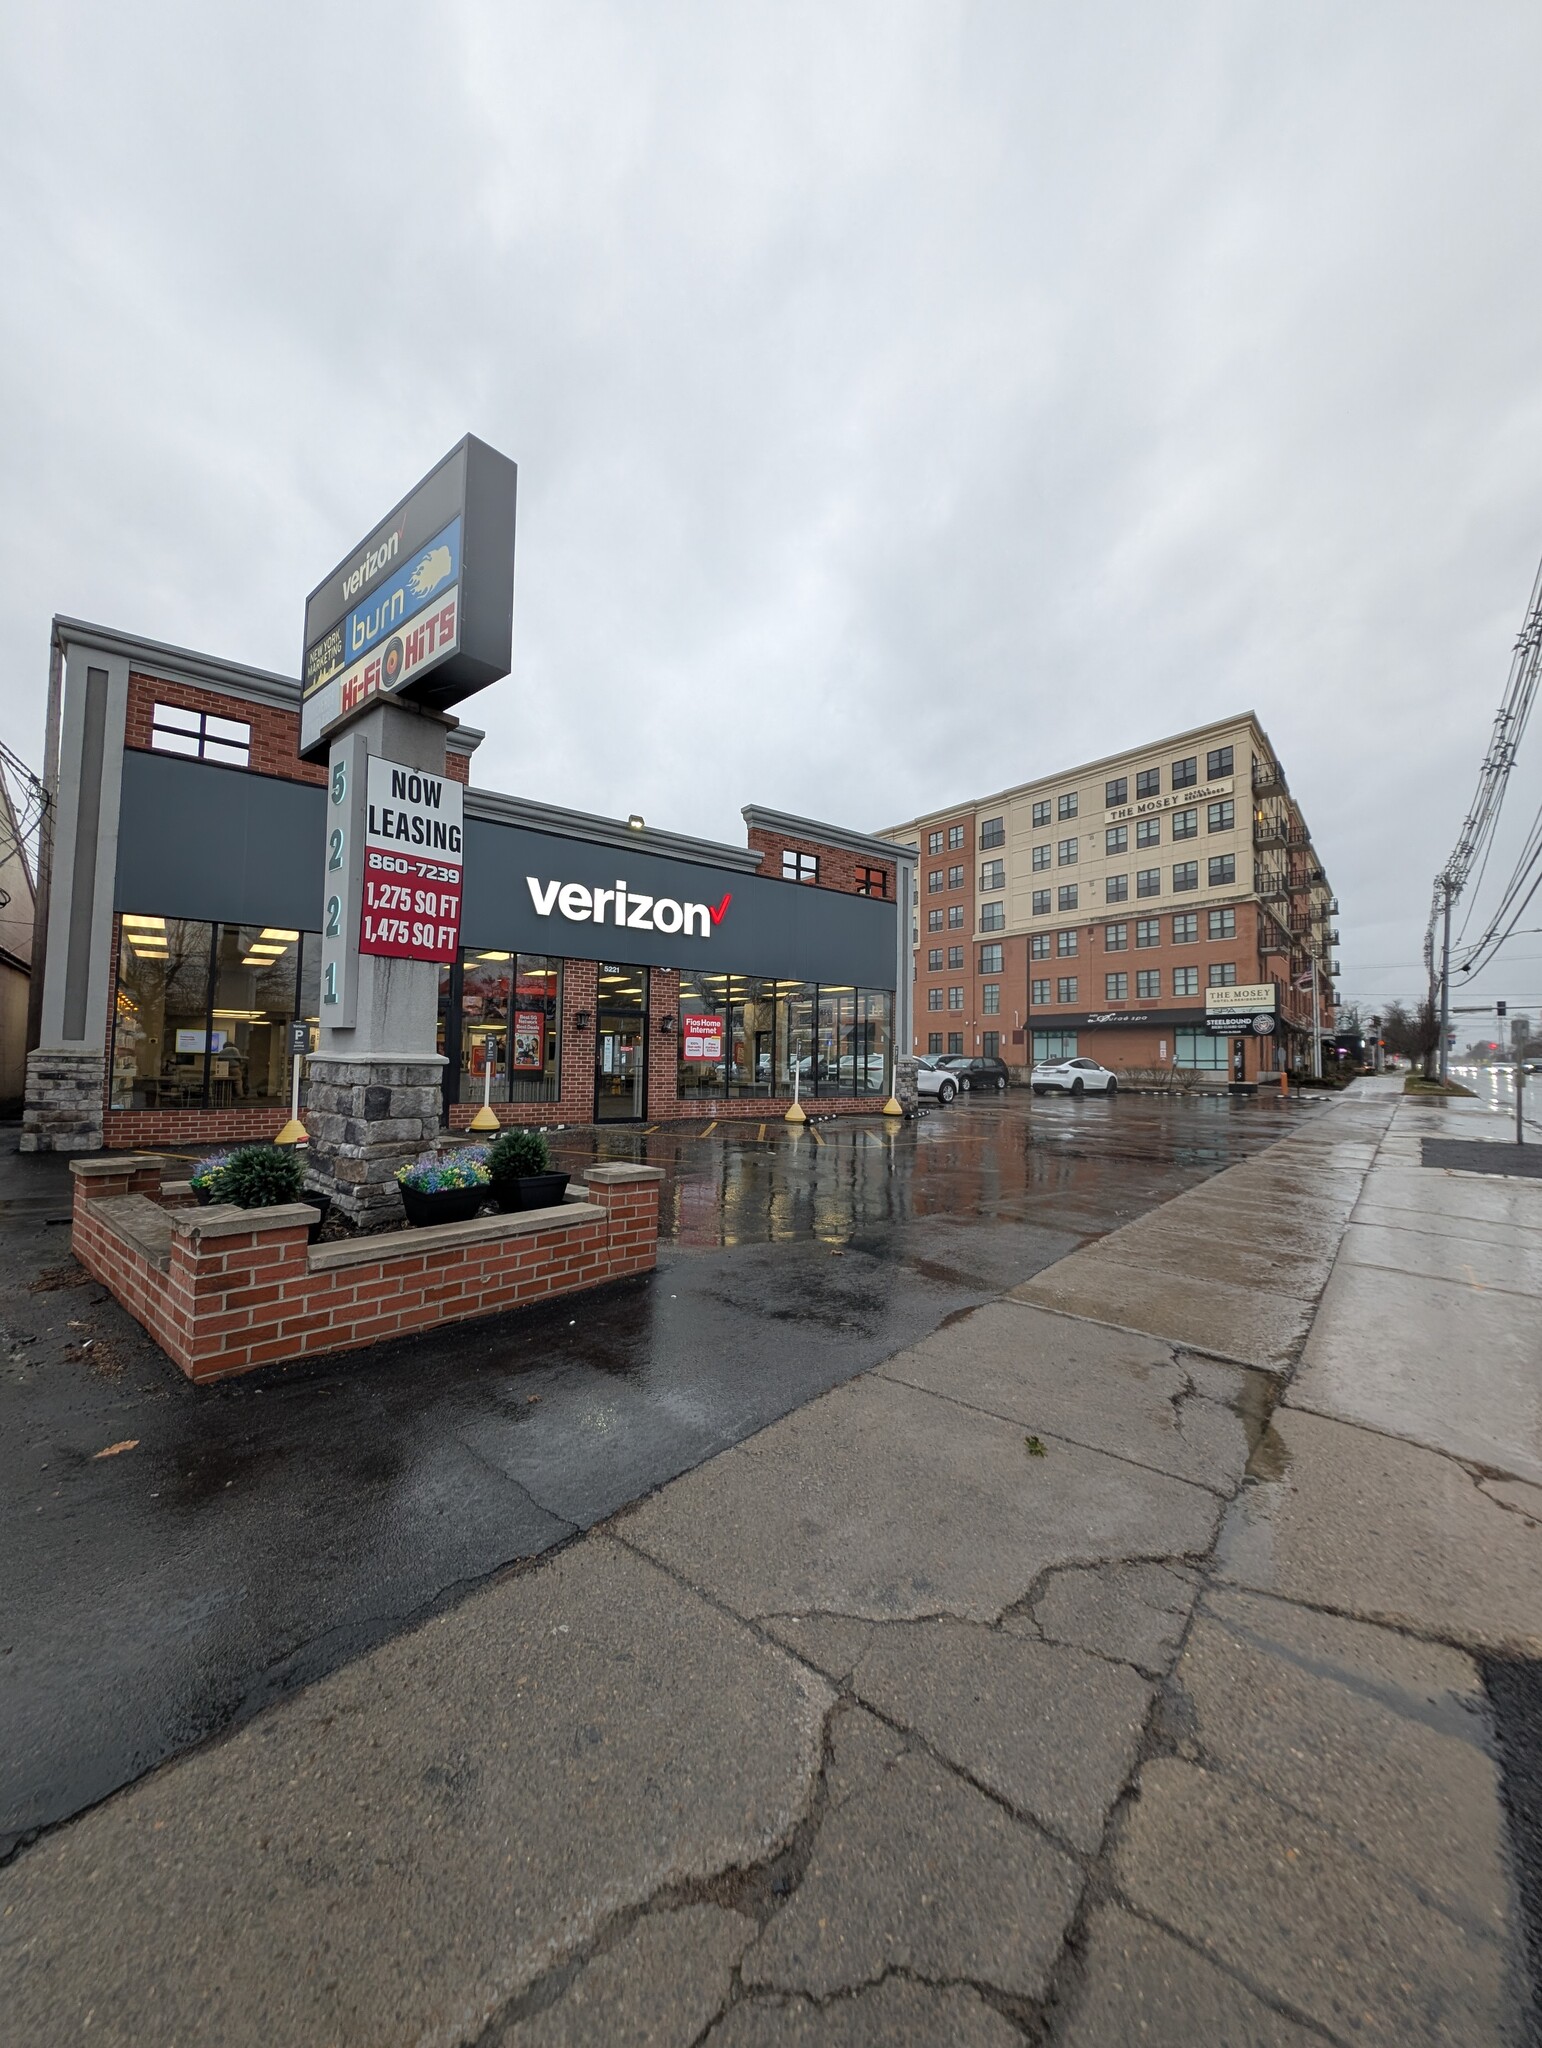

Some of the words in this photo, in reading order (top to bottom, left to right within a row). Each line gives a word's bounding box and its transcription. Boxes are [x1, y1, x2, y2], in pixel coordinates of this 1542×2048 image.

[342, 530, 399, 601] verizon
[352, 587, 404, 651] burn
[307, 640, 342, 679] MARKETING
[309, 643, 323, 665] NEW
[323, 627, 341, 650] YORK
[391, 769, 442, 809] NOW
[1111, 807, 1134, 820] THE
[1137, 795, 1179, 813] MOSEY
[369, 804, 461, 854] LEASING
[368, 852, 460, 885] 860-7239
[367, 881, 411, 912] 1,275
[414, 890, 437, 918] SQ
[439, 894, 458, 919] FT
[526, 876, 711, 938] verizon
[364, 915, 409, 943] 1,475
[411, 921, 435, 949] SQ
[437, 925, 457, 950] FT
[604, 965, 620, 974] 5221
[1210, 991, 1230, 999] THE
[1234, 989, 1270, 998] MOSEY
[295, 1029, 304, 1041] P
[686, 1018, 701, 1026] Fios
[701, 1019, 721, 1028] Home
[690, 1025, 717, 1034] Internet
[1206, 1018, 1252, 1026] STEELBOUND
